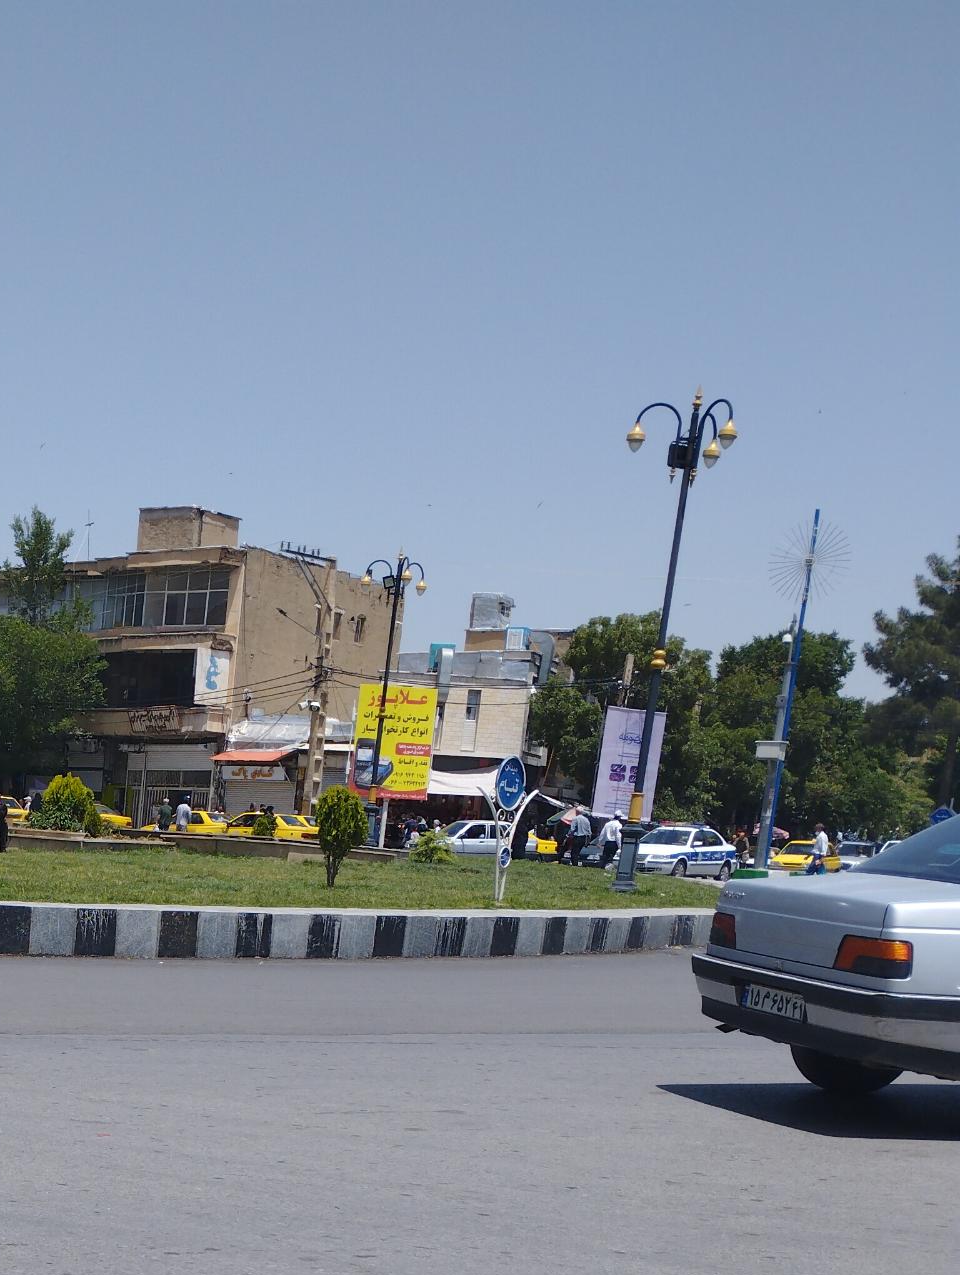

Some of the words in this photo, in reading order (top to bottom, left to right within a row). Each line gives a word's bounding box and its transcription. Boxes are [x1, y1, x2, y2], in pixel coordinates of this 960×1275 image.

[402, 712, 429, 723] فروش
[383, 725, 409, 736] کارتخوا
[410, 726, 428, 737] انواع
[500, 778, 520, 796] قیام
[750, 987, 760, 1007] ۱۵
